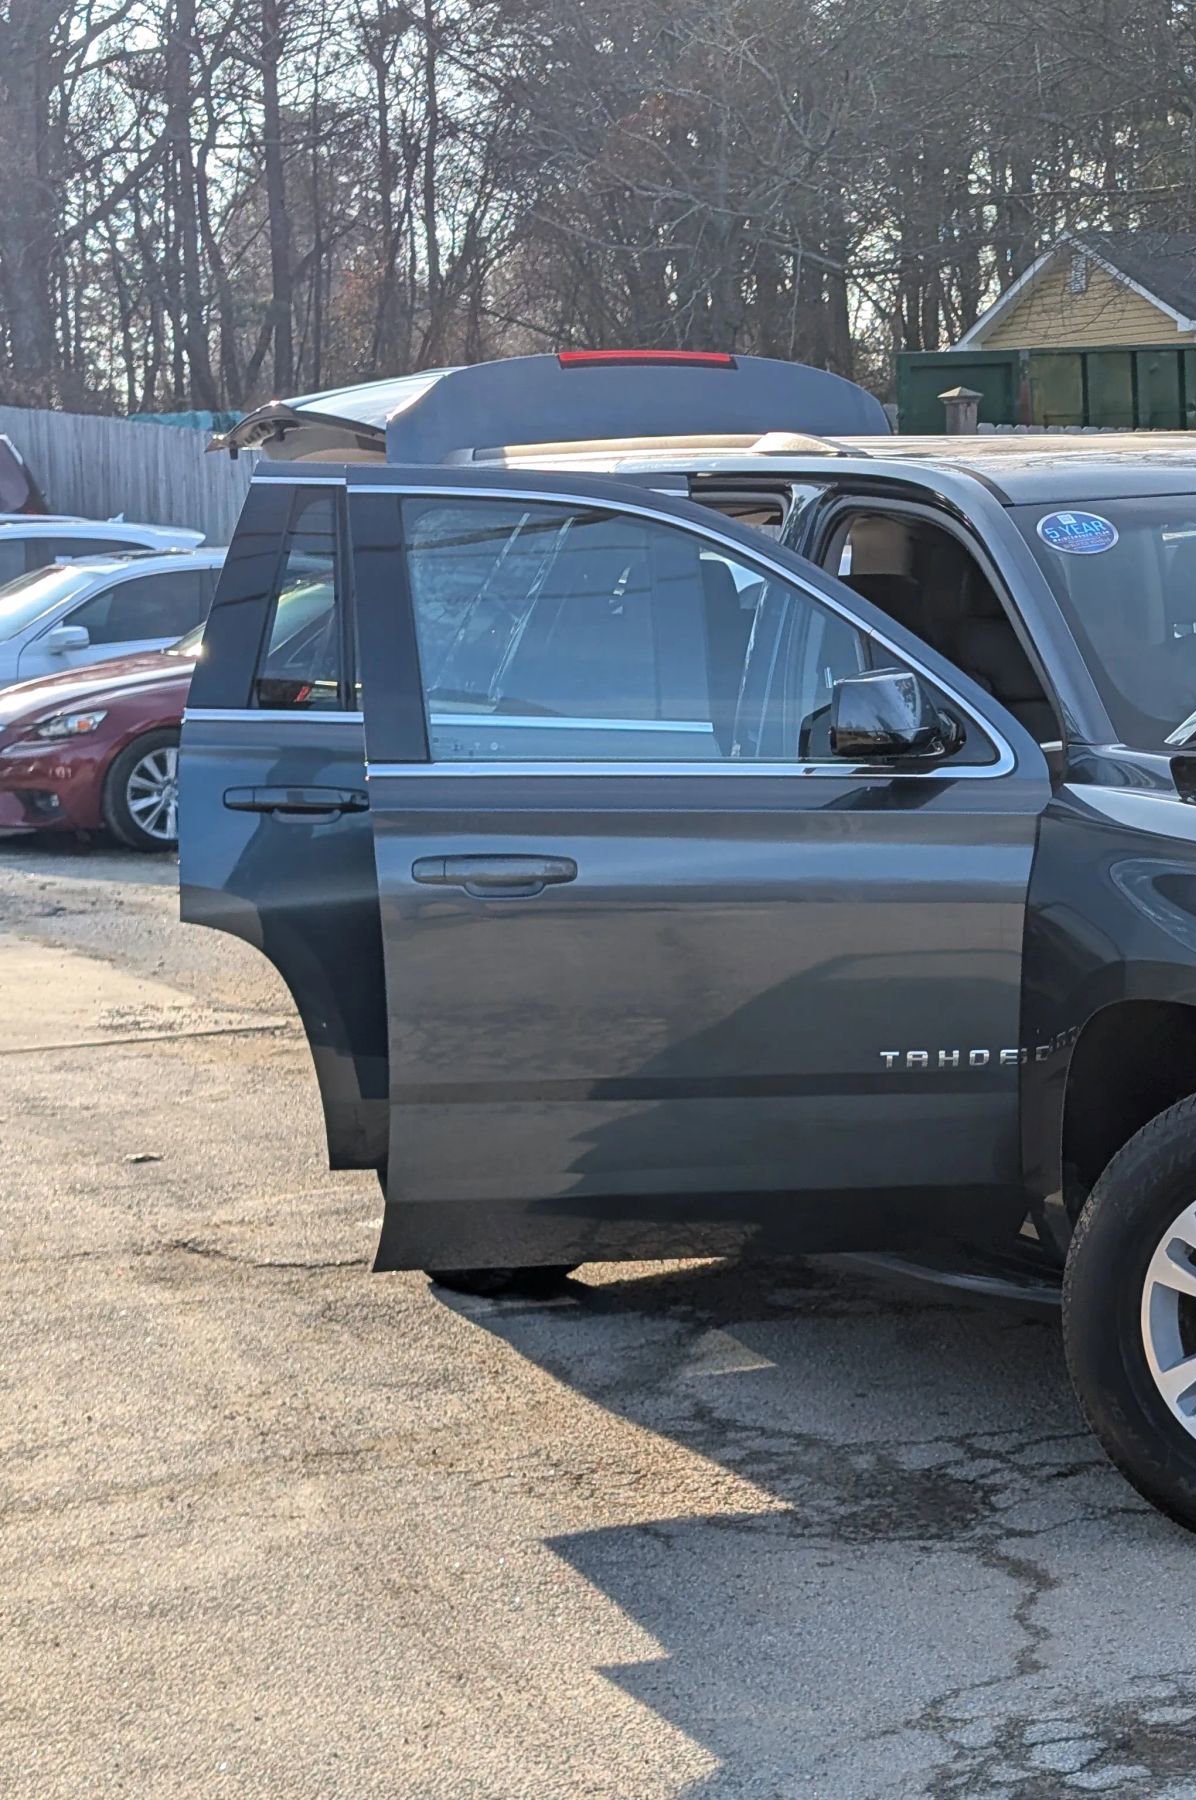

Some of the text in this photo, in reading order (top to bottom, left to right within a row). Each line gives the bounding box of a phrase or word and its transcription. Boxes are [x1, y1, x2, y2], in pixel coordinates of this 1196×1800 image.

[1044, 520, 1106, 539] 5 YEAR
[880, 1049, 1018, 1067] TAHOE
